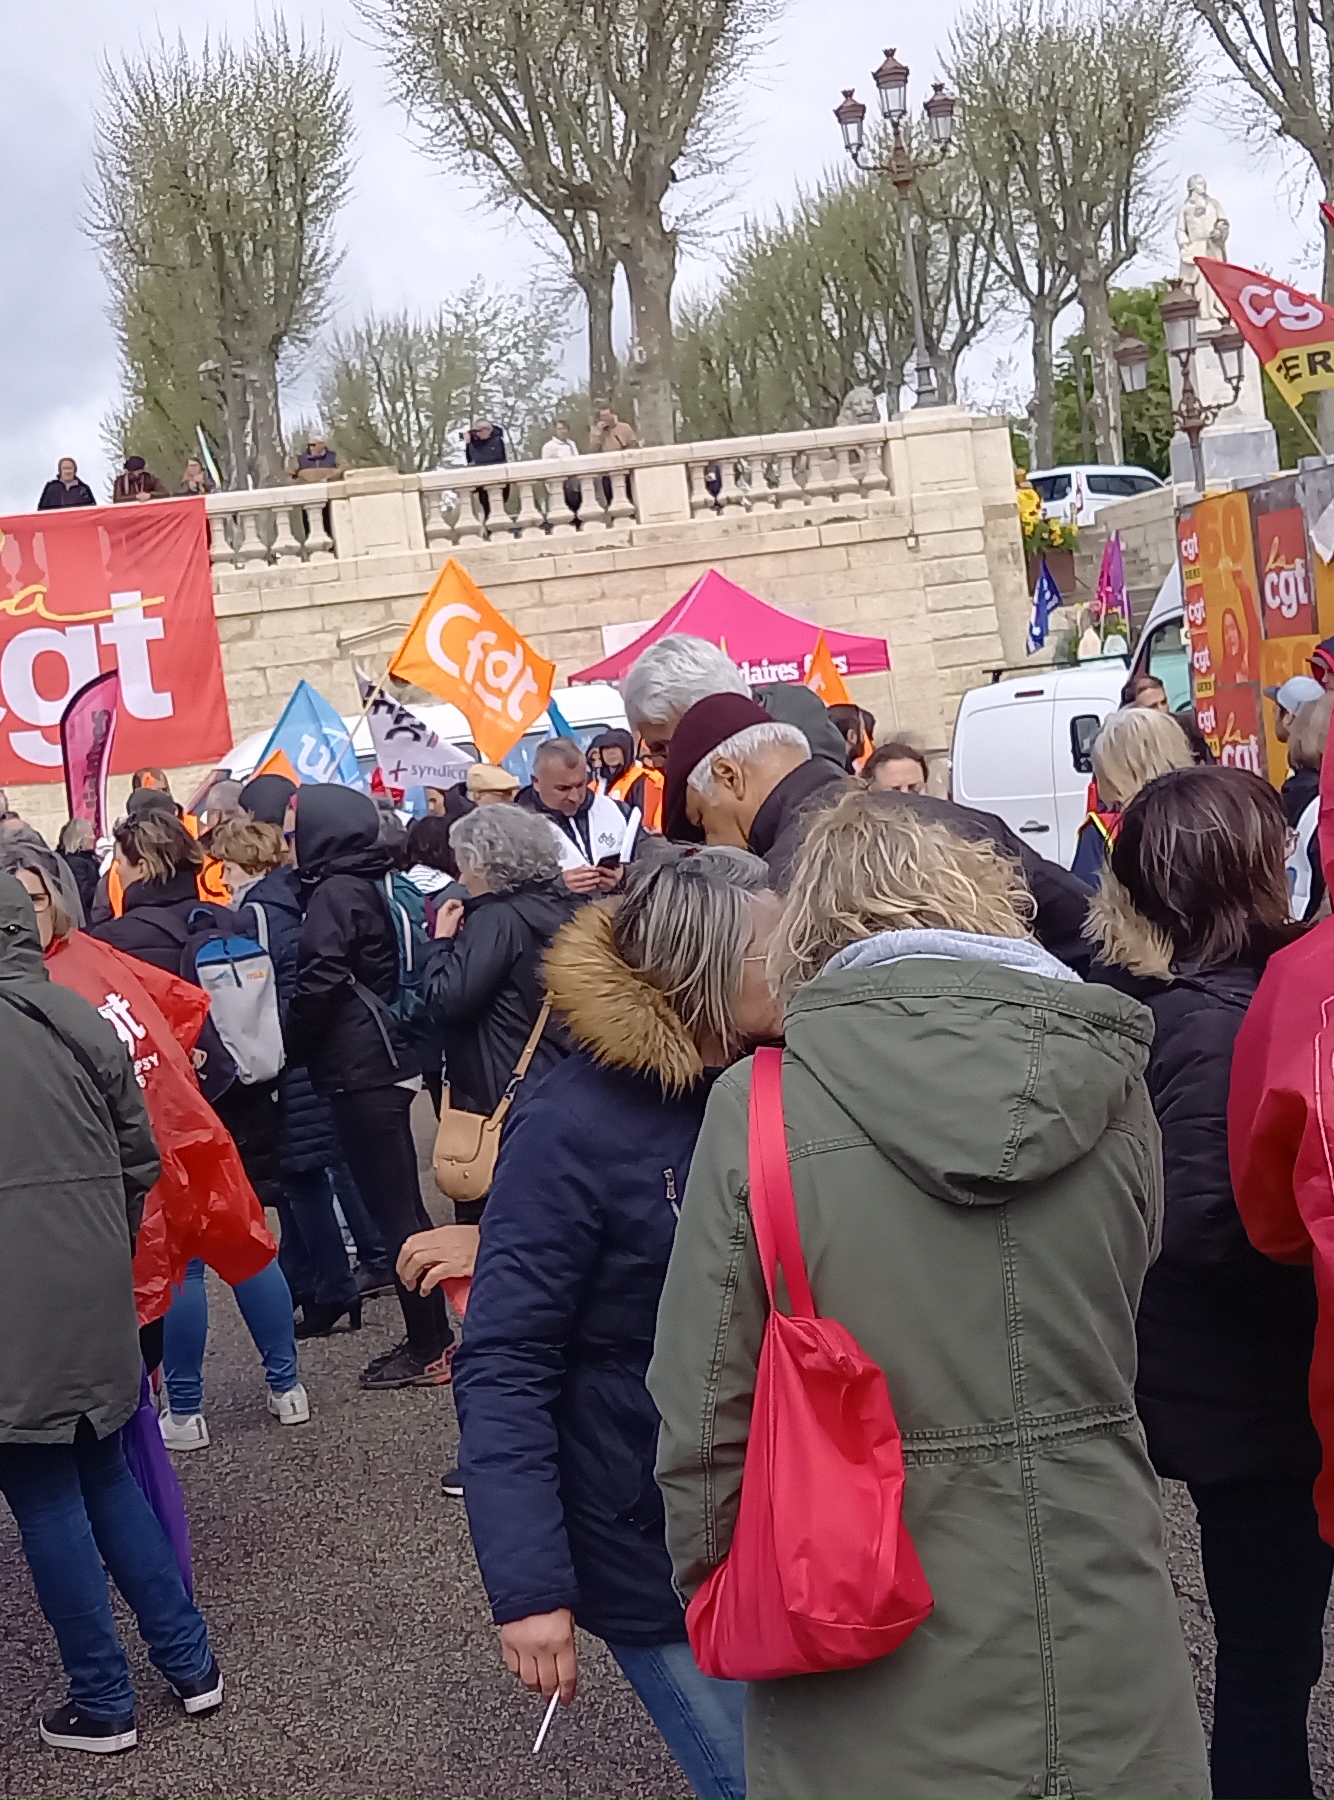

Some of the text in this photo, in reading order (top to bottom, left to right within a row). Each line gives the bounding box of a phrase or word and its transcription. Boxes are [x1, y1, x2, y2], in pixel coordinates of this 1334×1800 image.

[1239, 285, 1324, 330] cg
[1264, 557, 1309, 619] cgt
[425, 602, 539, 724] Cfdt
